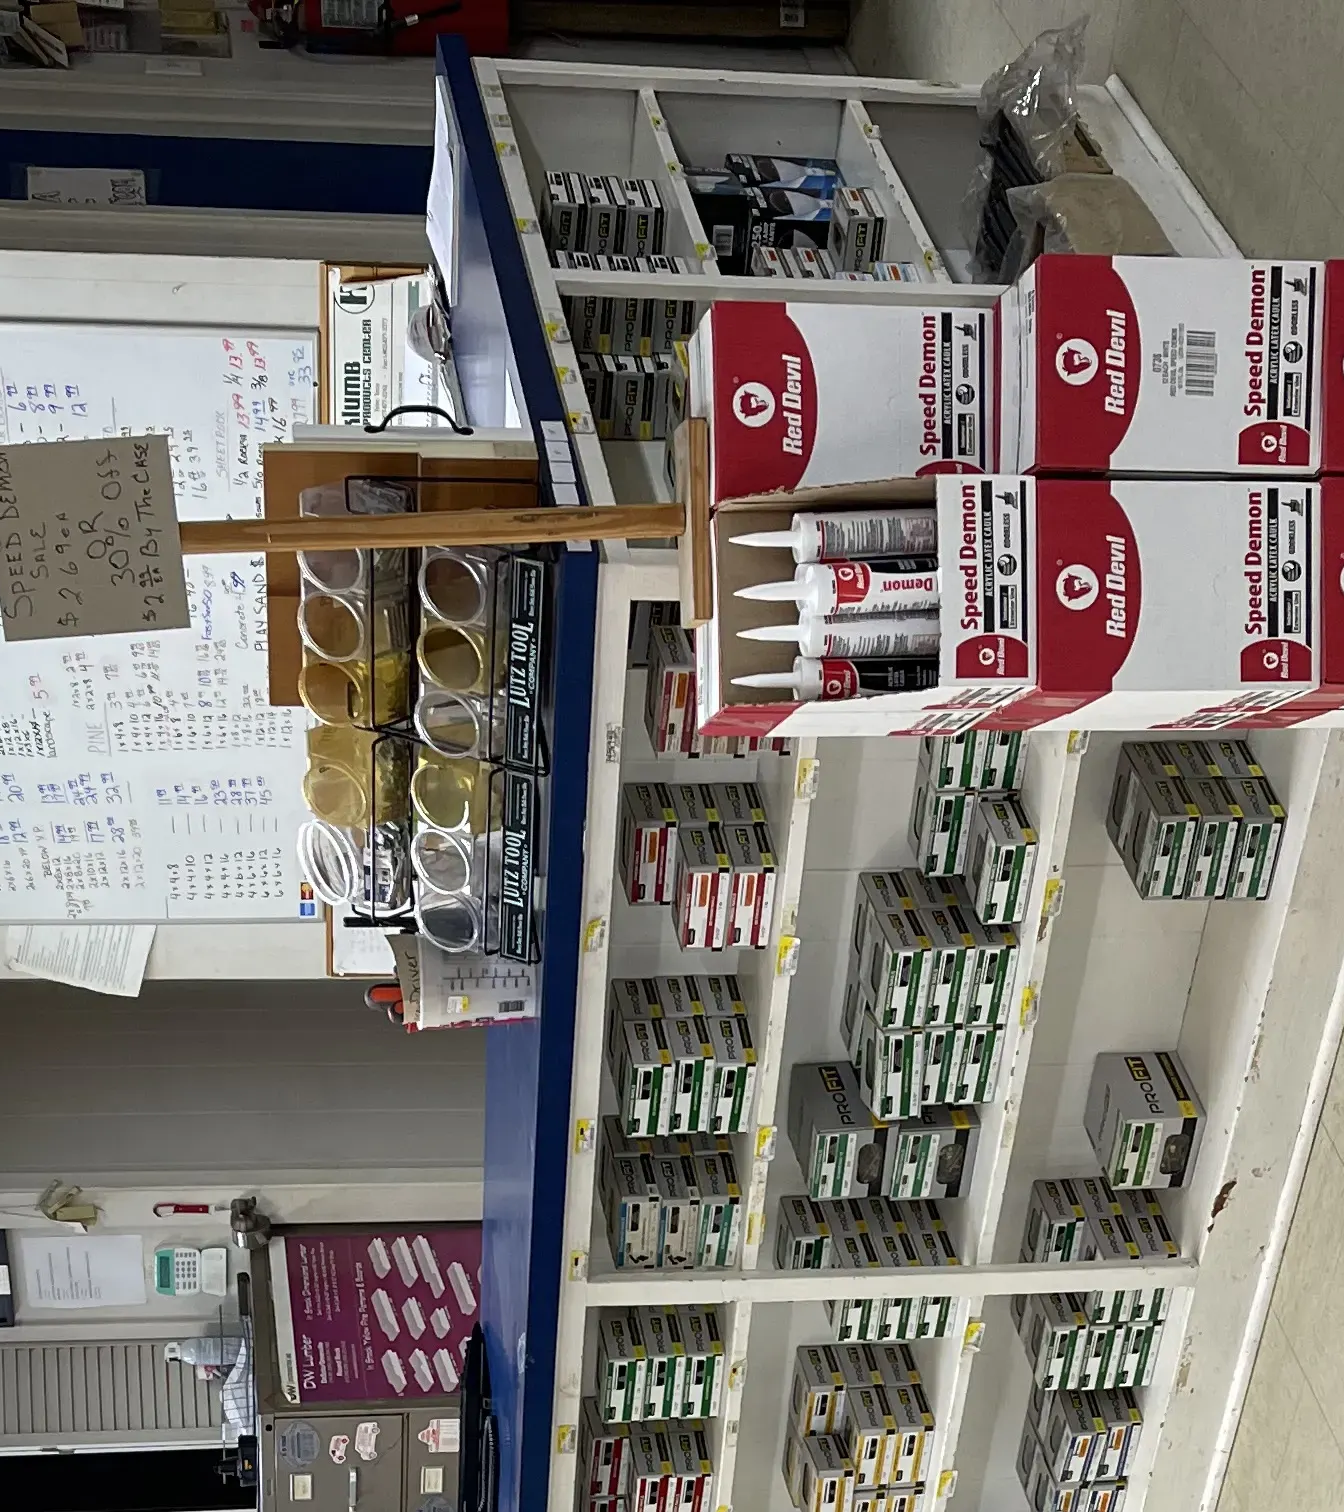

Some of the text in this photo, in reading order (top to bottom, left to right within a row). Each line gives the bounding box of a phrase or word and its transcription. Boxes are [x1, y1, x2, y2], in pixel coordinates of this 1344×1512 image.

[943, 342, 952, 424] ACRYLIC LATEX CAULK
[1105, 309, 1126, 415] Red Devil
[1244, 269, 1265, 417] Speed Demon
[1270, 297, 1280, 384] ACRYLIC LATEX CAULK
[782, 353, 802, 455] Red Devil
[919, 316, 940, 456] Speed Demon
[131, 443, 149, 483] CASE
[4, 532, 35, 618] SPEED
[29, 522, 49, 579] SALE
[78, 511, 106, 559] OR
[959, 485, 983, 630] Speed Demon
[983, 511, 994, 597] ACRYLIC LATEX CAULK
[1244, 492, 1266, 635] Speed Demon
[1269, 518, 1278, 602] ACRYLIC LATEX CAULK
[883, 578, 933, 591] Demon
[1106, 535, 1126, 638] Red Devil
[509, 622, 534, 708] LUTZ TOOL
[527, 643, 537, 690] COMPANY
[86, 722, 106, 753] PINE
[503, 829, 526, 907] LUTZ TOOL
[520, 848, 530, 891] COMPANY
